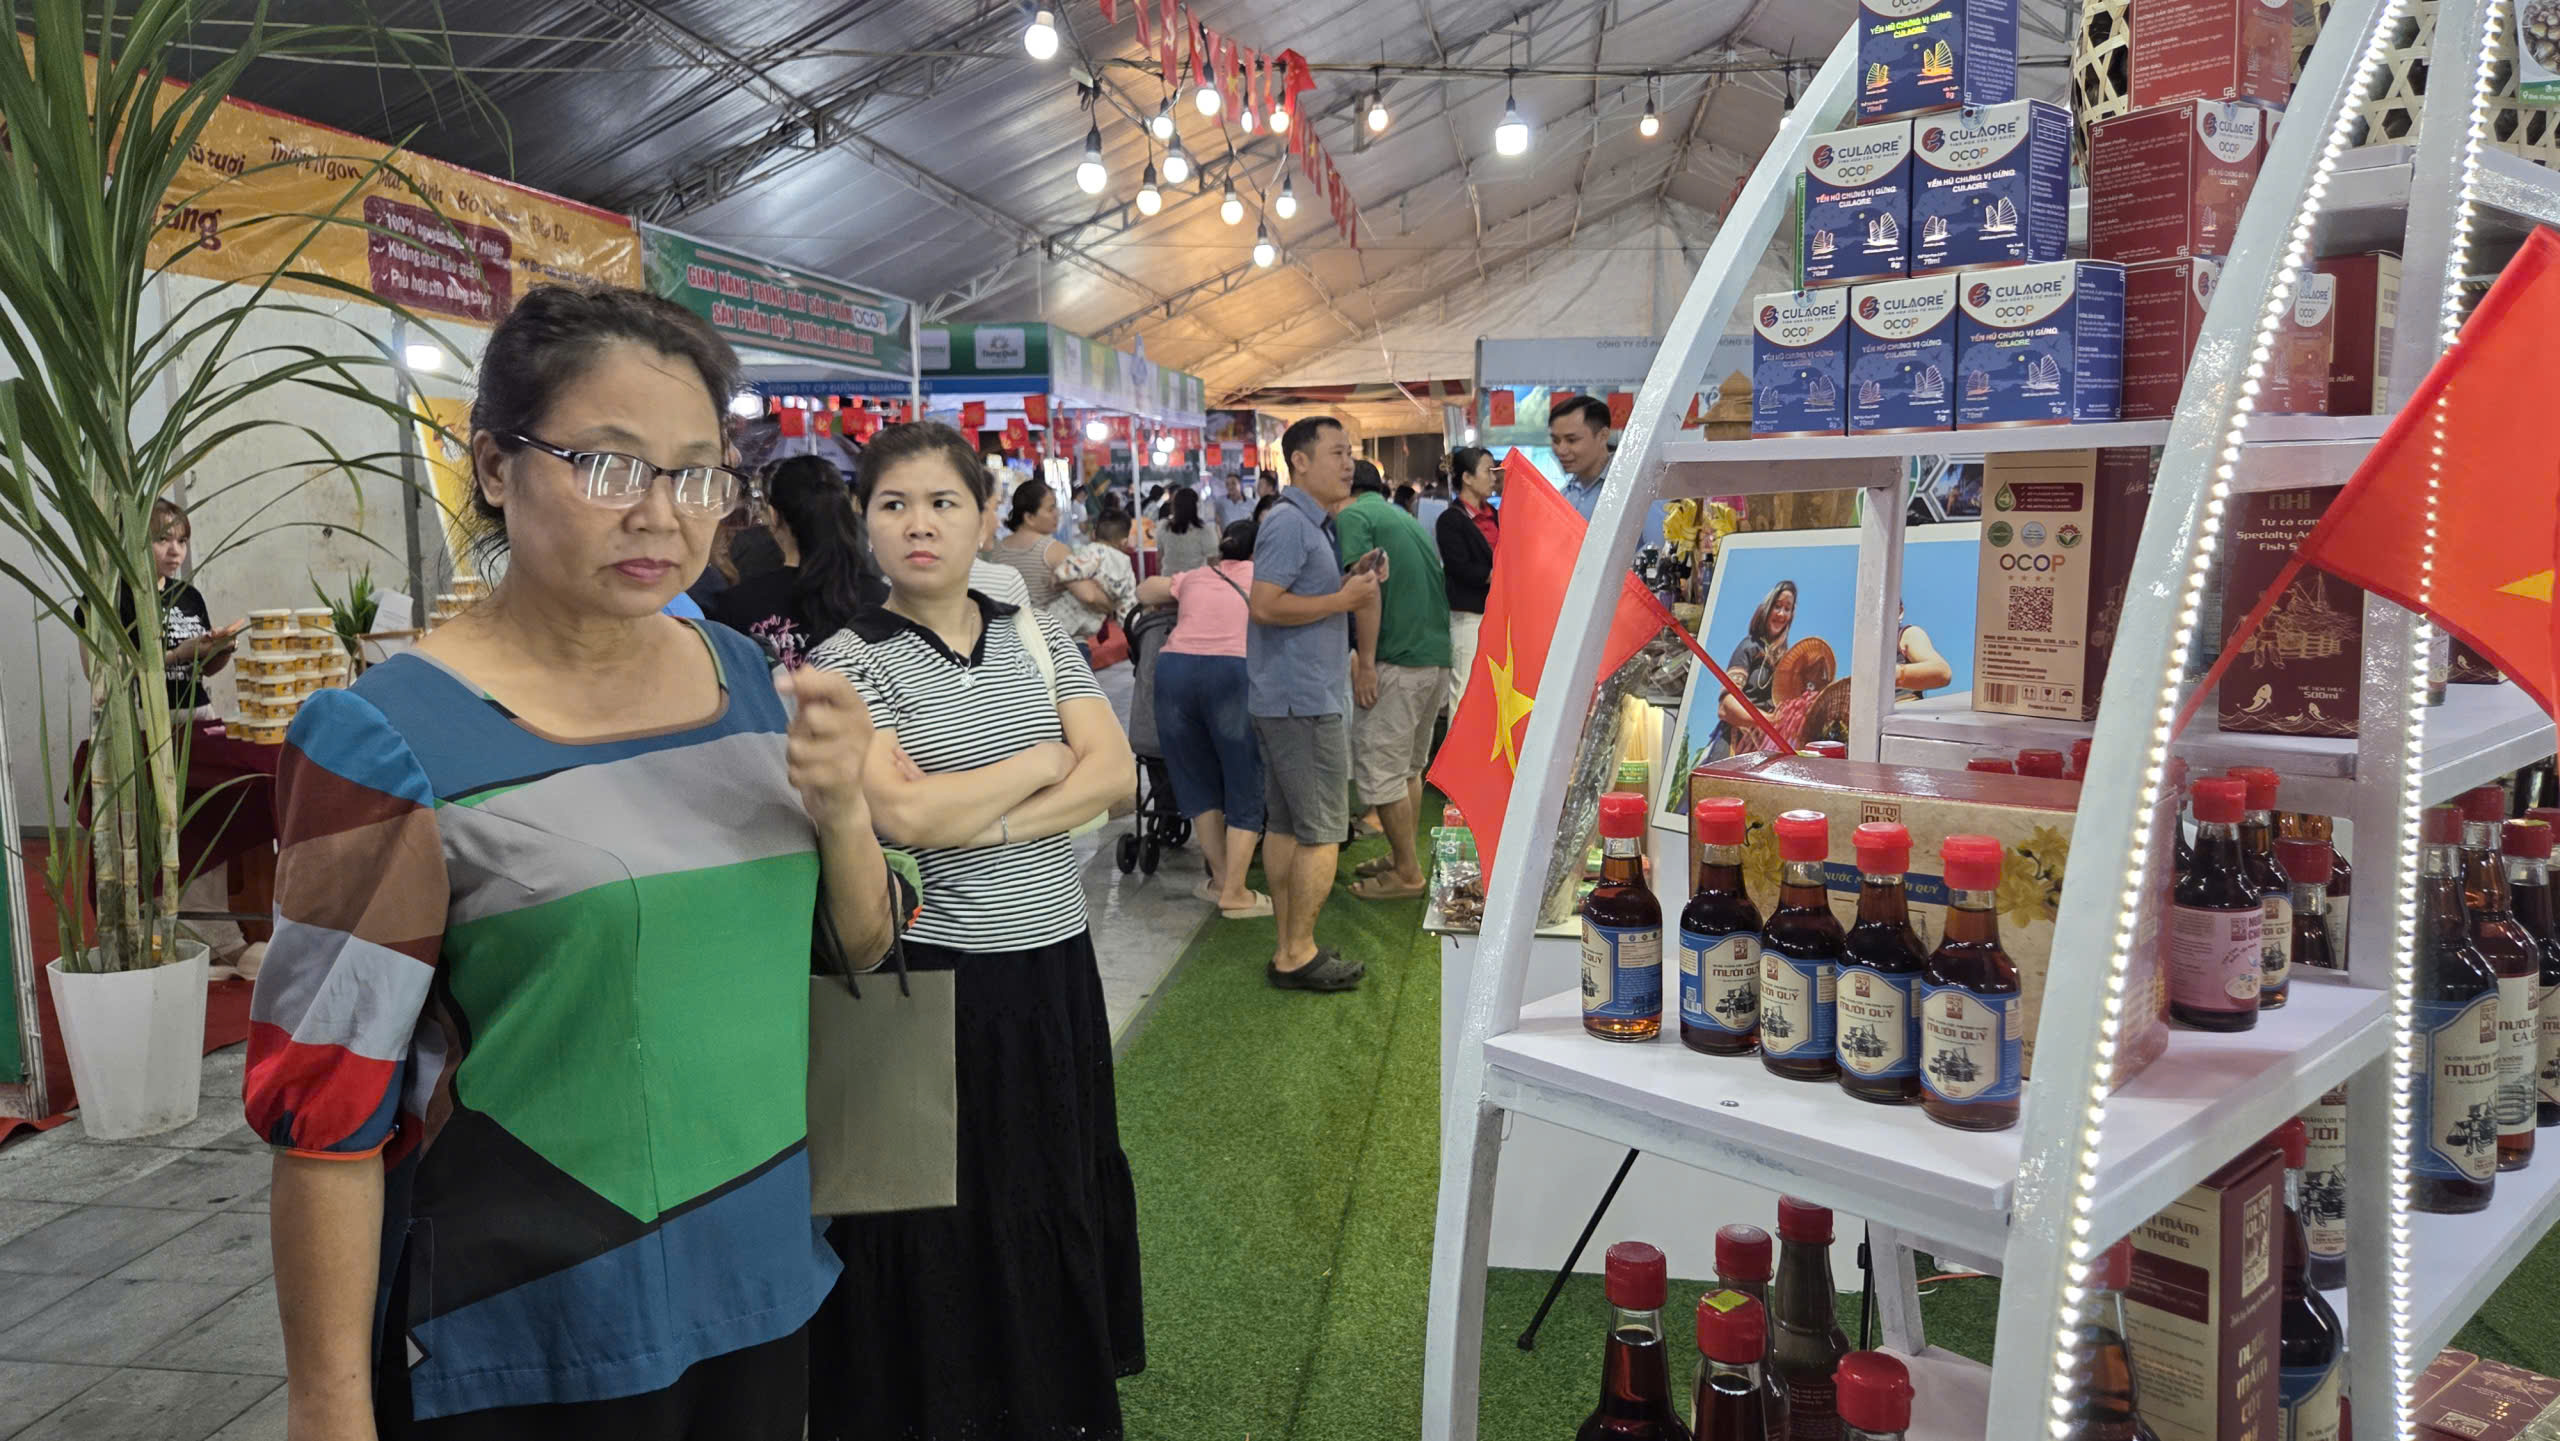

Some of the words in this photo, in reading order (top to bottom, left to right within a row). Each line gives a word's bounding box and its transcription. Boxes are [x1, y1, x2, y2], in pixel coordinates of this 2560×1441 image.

[1950, 121, 2017, 142] CULAORE
[2219, 120, 2254, 136] CULAORE
[1838, 140, 1899, 159] CULAORE
[2219, 141, 2240, 152] OCOP
[1950, 147, 1989, 162] OCOP
[314, 152, 363, 181] Ngon
[1838, 164, 1873, 178] OCOP
[1955, 173, 1983, 185] CHƯNG
[1984, 171, 1992, 182] VỊ
[1842, 189, 1866, 201] CHƯNG
[1867, 188, 1874, 198] VỊ
[1952, 182, 1989, 193] CULAORE
[1839, 197, 1872, 208] CULAORE
[385, 212, 416, 236] 100%
[387, 239, 421, 268] Không
[687, 264, 717, 292] GIAN
[718, 271, 751, 300] HÀNG
[1995, 280, 2063, 298] CULAORE
[1883, 294, 1945, 311] CULAORE
[712, 297, 736, 328] SẢN
[738, 305, 770, 334] PHẨM
[1782, 304, 1837, 320] CULAORE
[1995, 304, 2034, 318] OCOP
[1883, 317, 1919, 330] OCOP
[1782, 327, 1814, 338] OCOP
[1998, 330, 2025, 340] CHƯNG
[2026, 329, 2034, 338] VỊ
[1596, 339, 1622, 349] CÔNG
[1624, 340, 1634, 349] TY
[2236, 530, 2293, 541] Specialty
[2259, 542, 2285, 551] Fish
[2000, 553, 2066, 573] OCOP
[2303, 691, 2340, 700] 500ml
[1914, 881, 1940, 895] QUÝ
